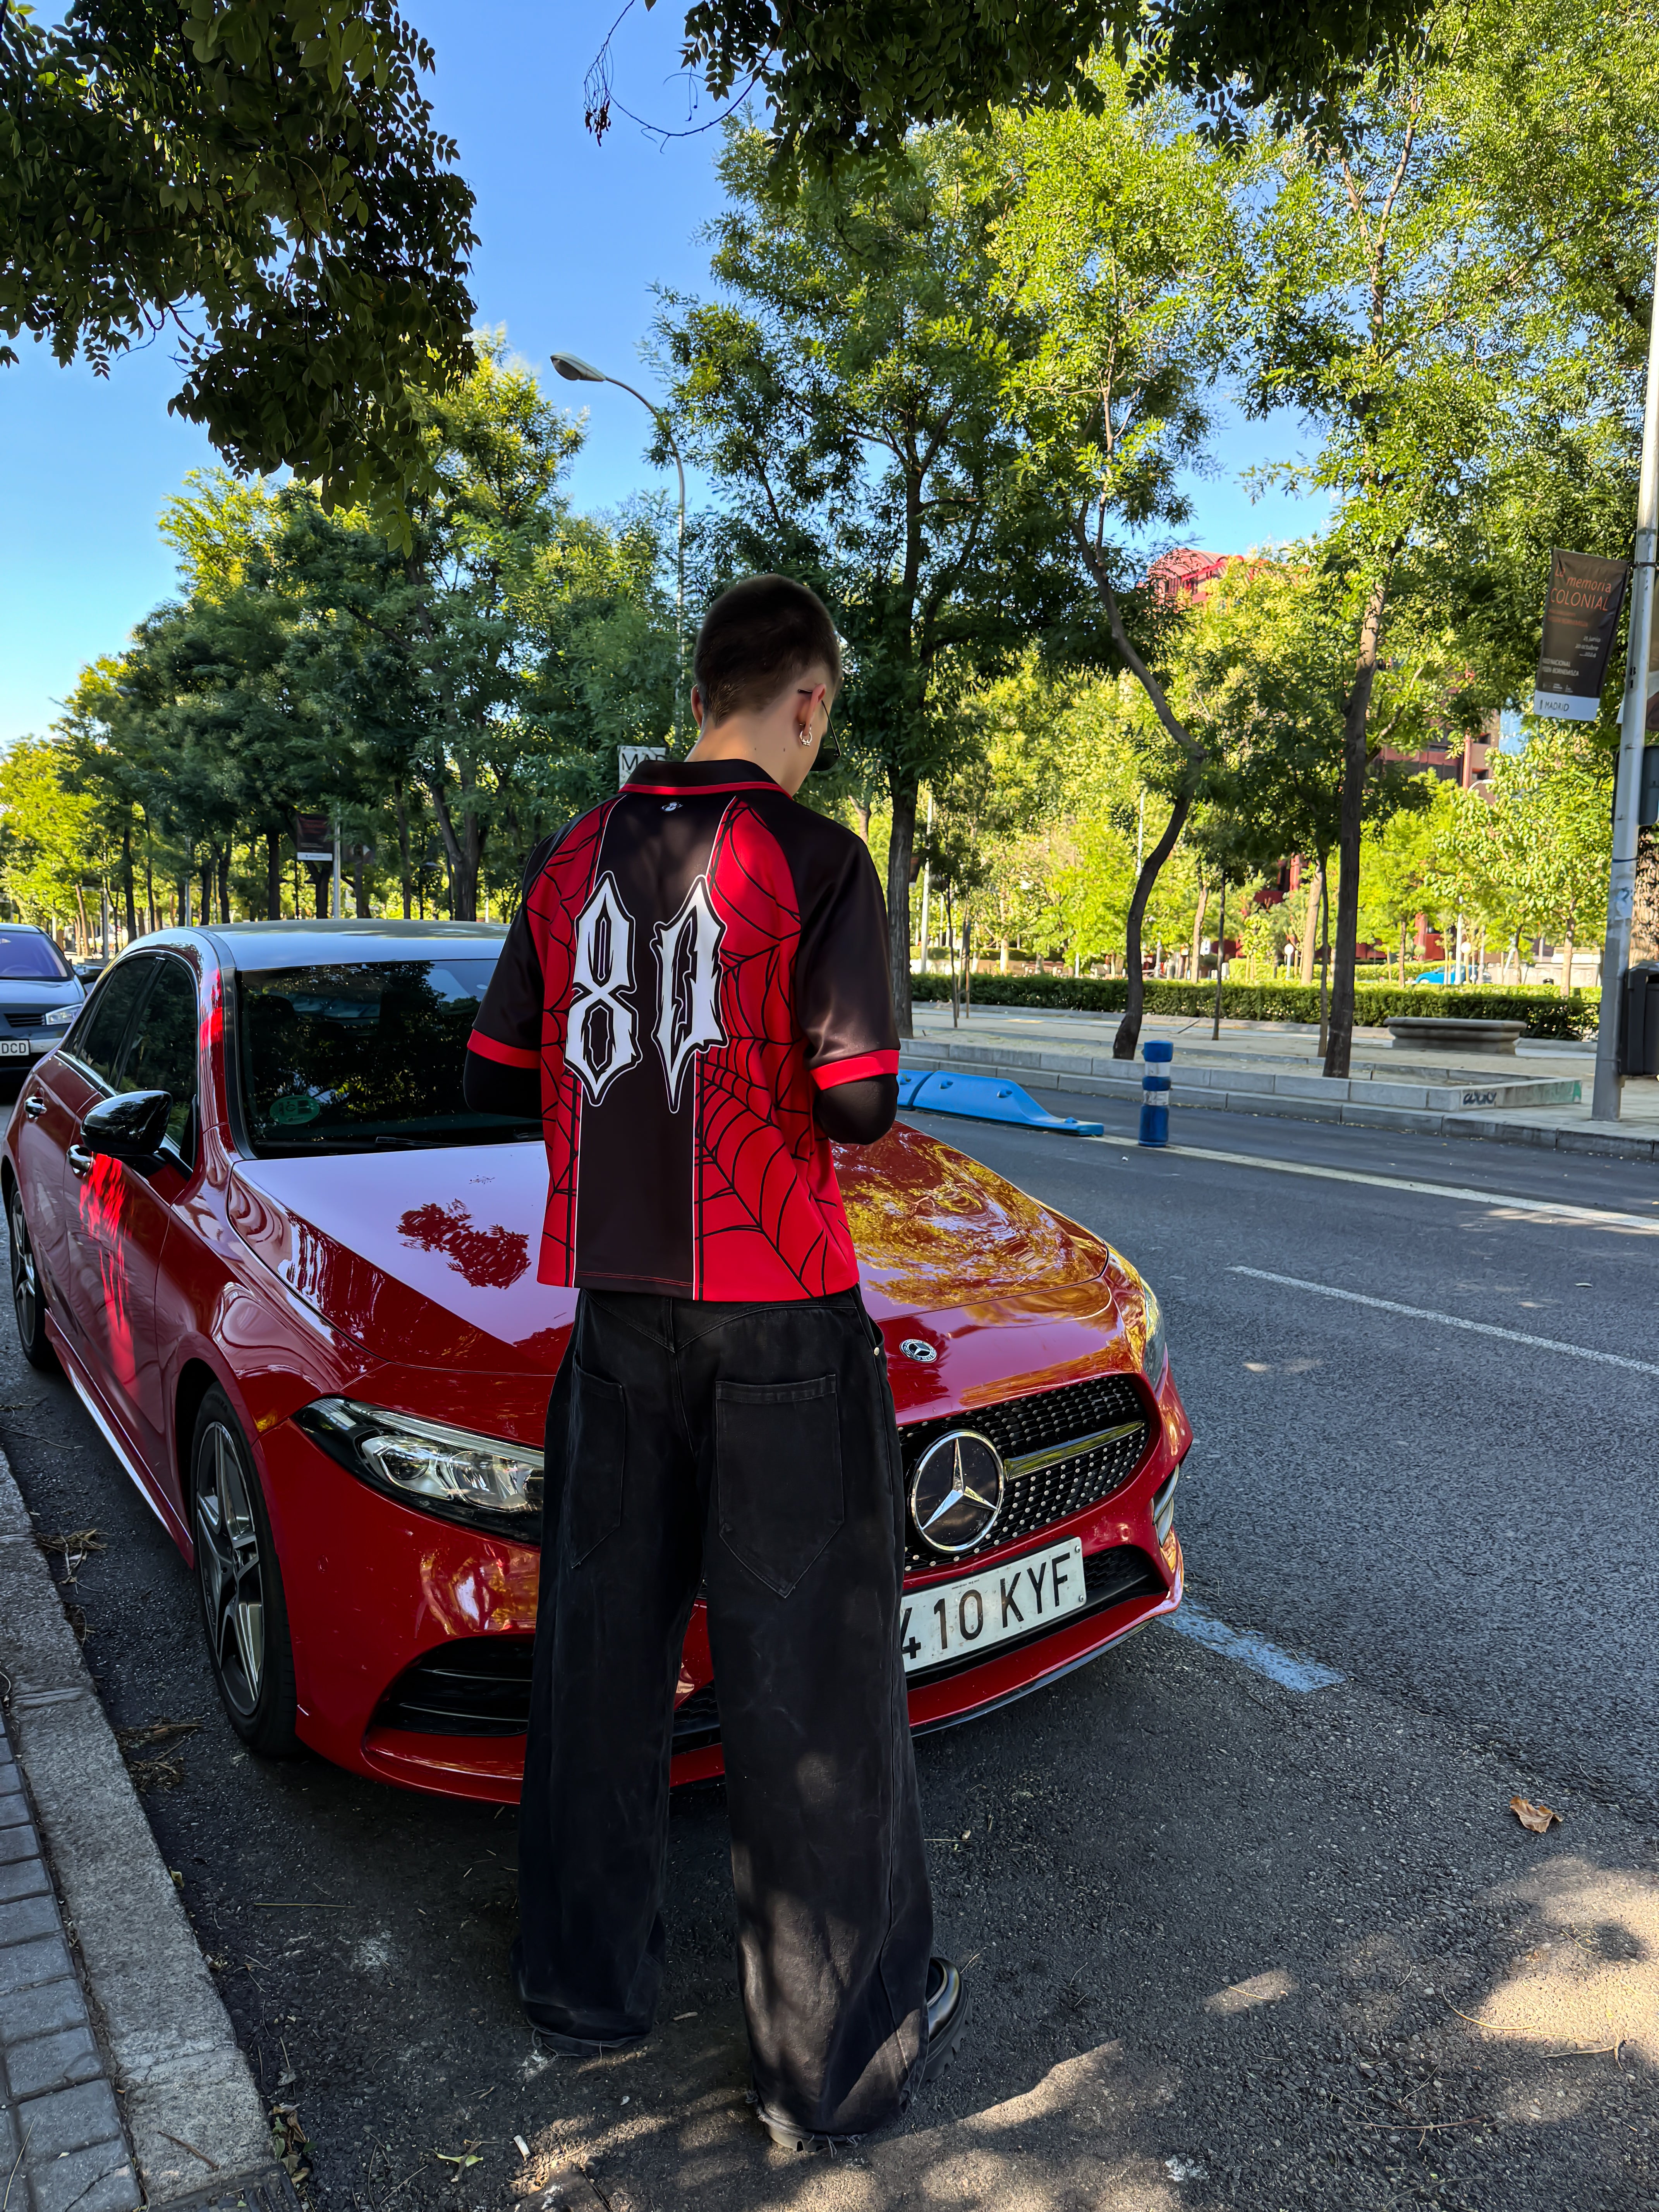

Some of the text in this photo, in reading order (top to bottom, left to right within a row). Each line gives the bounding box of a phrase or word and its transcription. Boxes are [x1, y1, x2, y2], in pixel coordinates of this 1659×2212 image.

[1555, 563, 1566, 577] La
[1566, 577, 1611, 593] memoria
[1550, 588, 1609, 611] COLONIAL
[1545, 701, 1570, 711] MADRID
[2, 1043, 26, 1053] DCD
[900, 1552, 1070, 1659] 410 KYF
